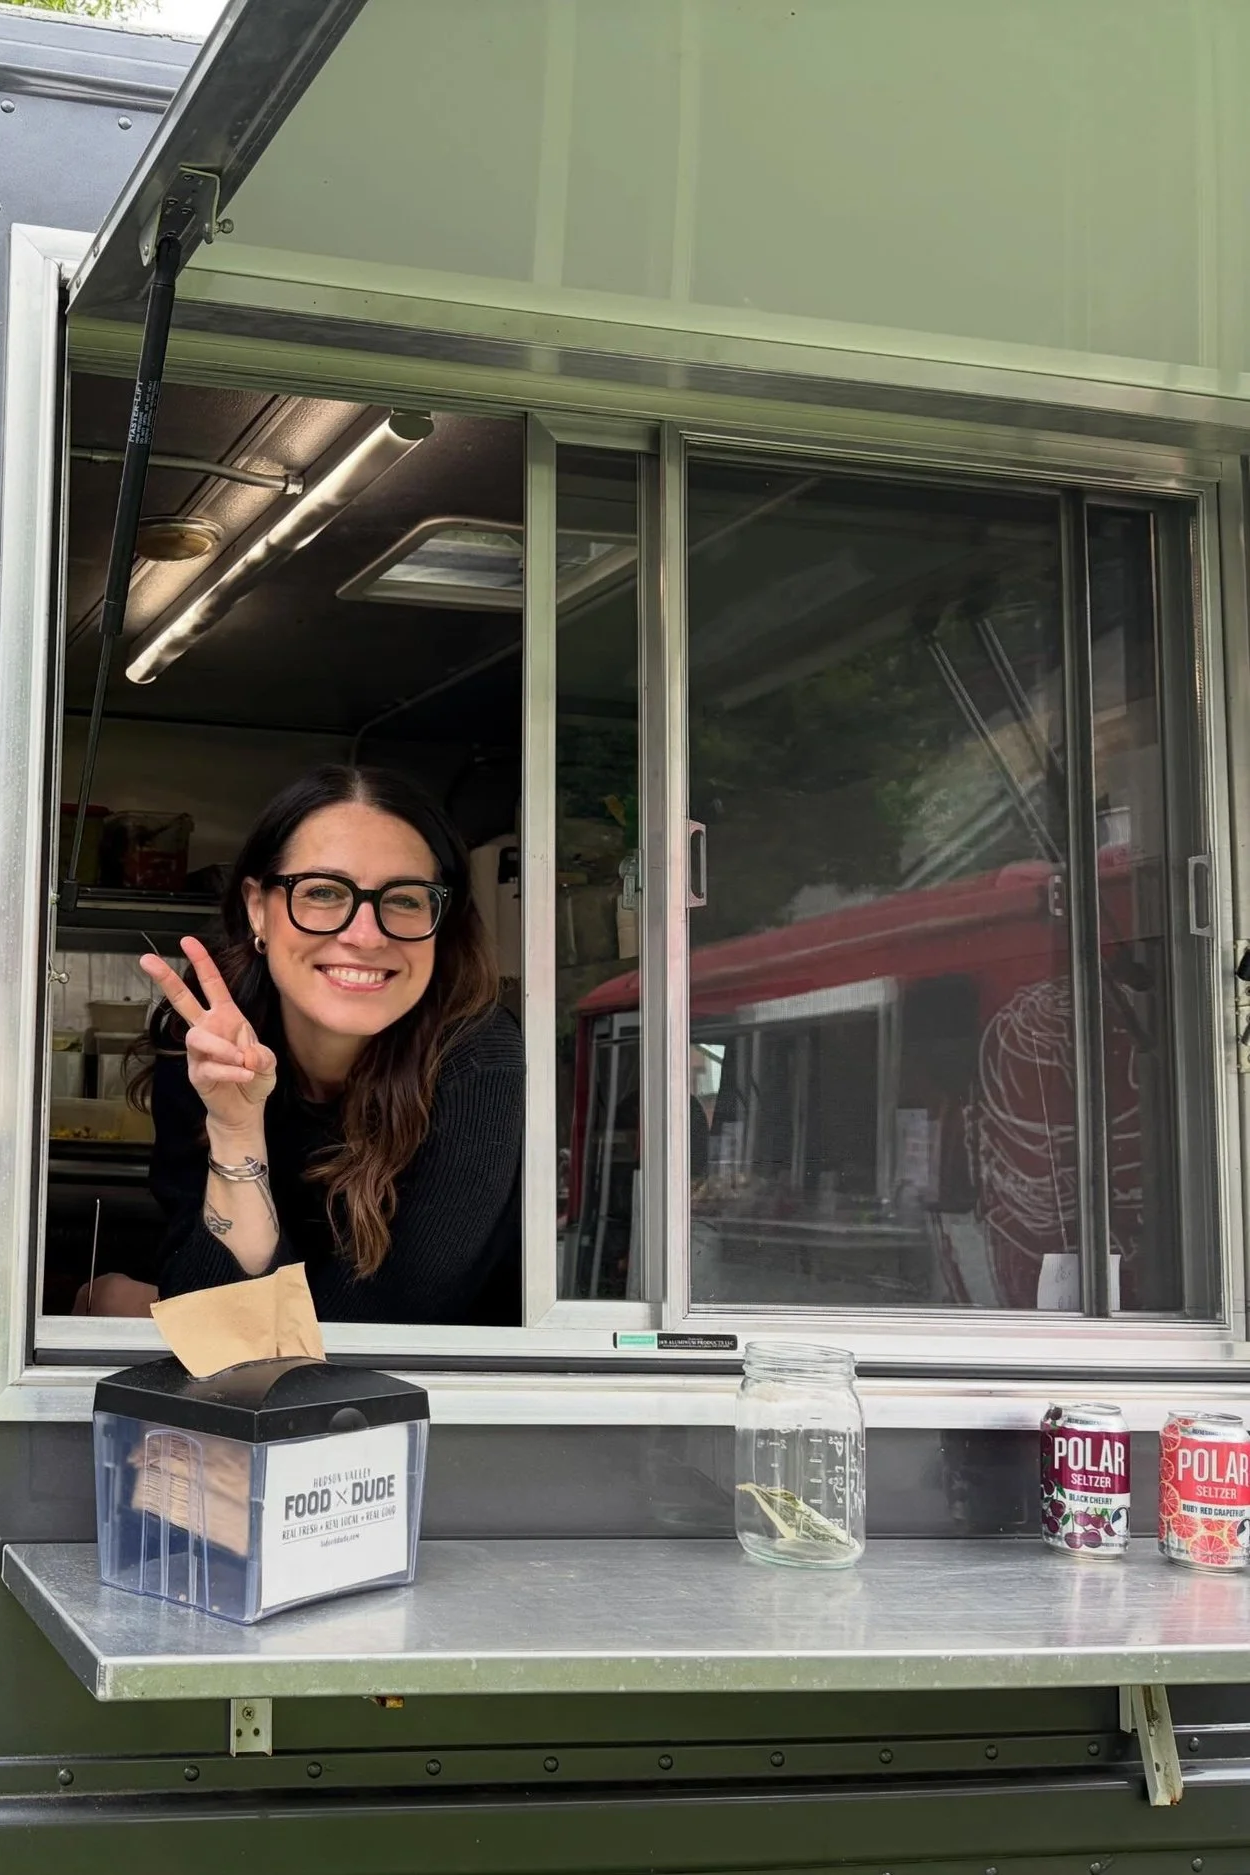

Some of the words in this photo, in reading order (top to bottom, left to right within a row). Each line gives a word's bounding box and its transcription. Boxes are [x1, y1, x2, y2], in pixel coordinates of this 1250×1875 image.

[128, 381, 144, 443] MASTER-LIFT
[1054, 1437, 1125, 1477] POLAR
[1177, 1449, 1250, 1487] POLAR
[313, 1472, 341, 1488] HUDSON
[344, 1468, 371, 1483] VALLEY
[1071, 1473, 1111, 1488] SELTZER
[285, 1488, 331, 1521] FOOD
[352, 1474, 395, 1506] DUDE
[1090, 1495, 1112, 1506] CHERRY
[1196, 1485, 1237, 1499] SELTZER
[1182, 1504, 1198, 1514] RUBY
[1200, 1506, 1213, 1516] RED
[299, 1523, 318, 1537] FRESH
